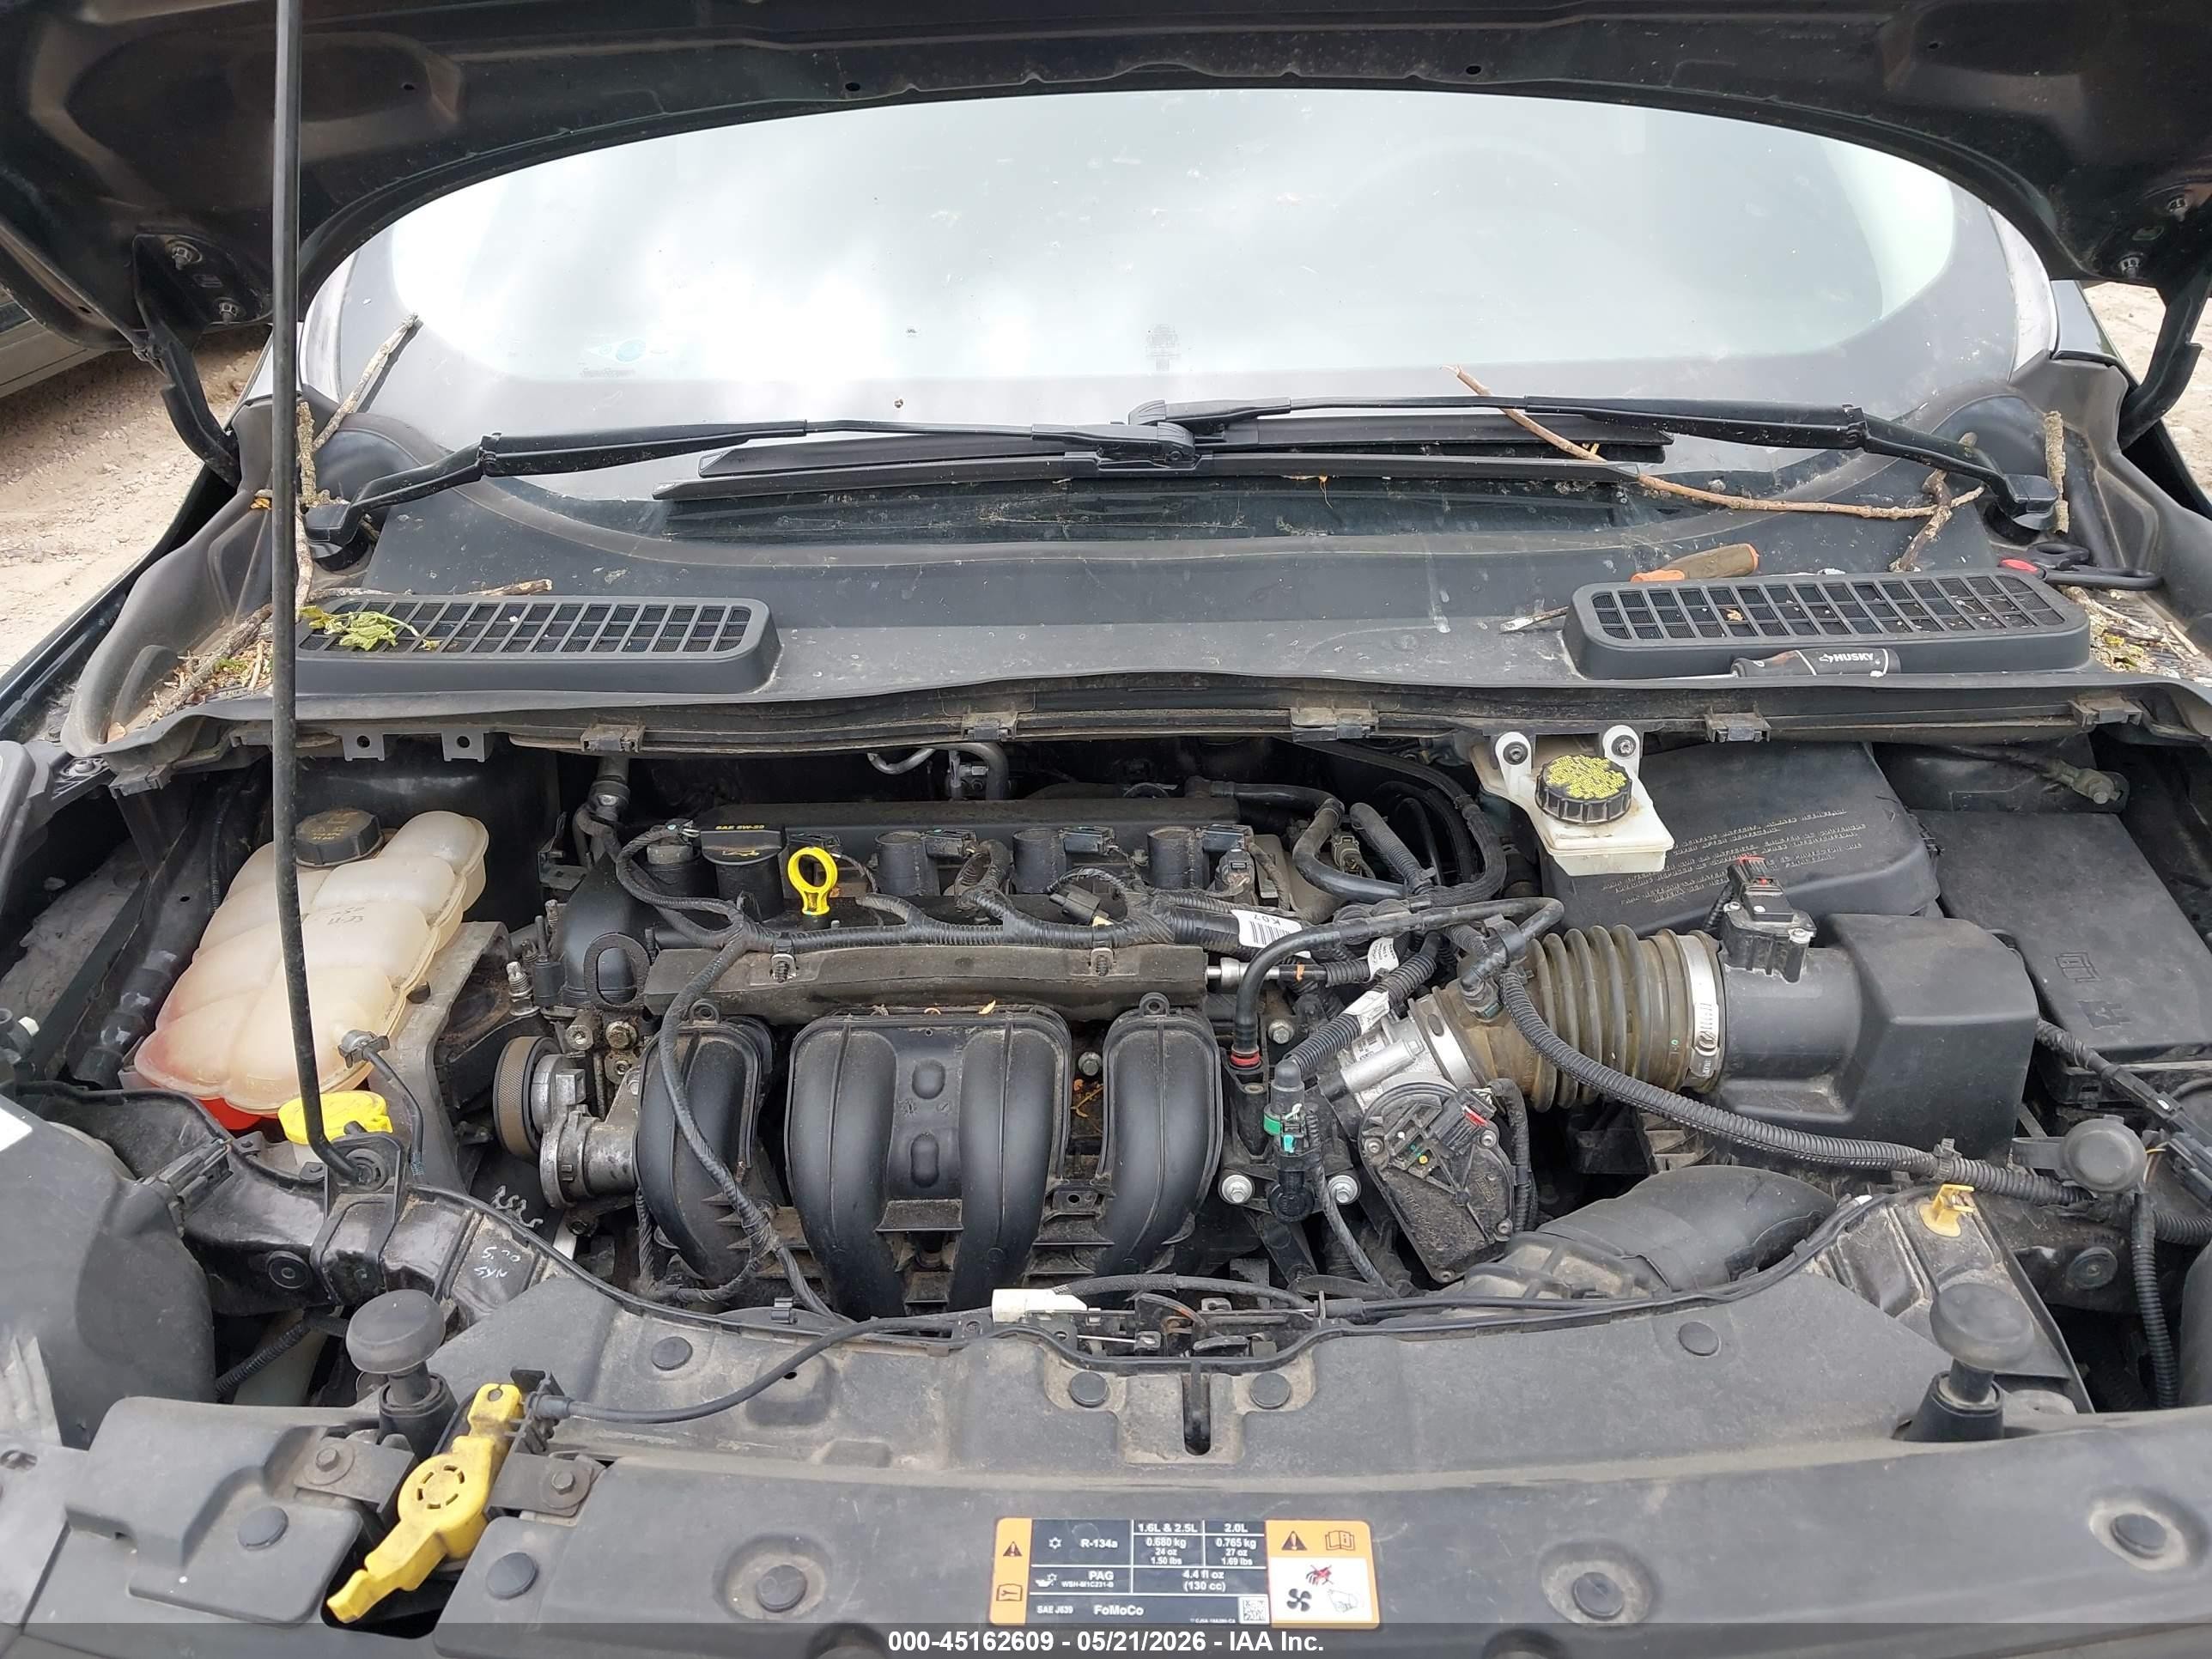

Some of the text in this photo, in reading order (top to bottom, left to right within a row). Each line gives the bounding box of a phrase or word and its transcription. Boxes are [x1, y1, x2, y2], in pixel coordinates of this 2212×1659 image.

[1833, 653, 1874, 661] HUSKY
[473, 1266, 508, 1279] SYN
[1138, 1523, 1198, 1533] 1.6L & 2.5L
[1224, 1523, 1249, 1534] 2.0L
[1080, 1538, 1119, 1548] R-134a
[1146, 1537, 1187, 1549] 0.680 kg
[1215, 1537, 1257, 1550] 0.765 kg
[1225, 1548, 1236, 1557] 27
[1151, 1557, 1182, 1565] 1.50 lbs
[1221, 1557, 1253, 1566] 1.69 lbs
[1088, 1571, 1115, 1581] PAG
[1182, 1570, 1200, 1579] 4.4
[1201, 1570, 1209, 1579] fl
[1183, 1581, 1226, 1592] (130 cc)
[1036, 1605, 1054, 1614] SAE
[1093, 1604, 1145, 1616] FoMoCo
